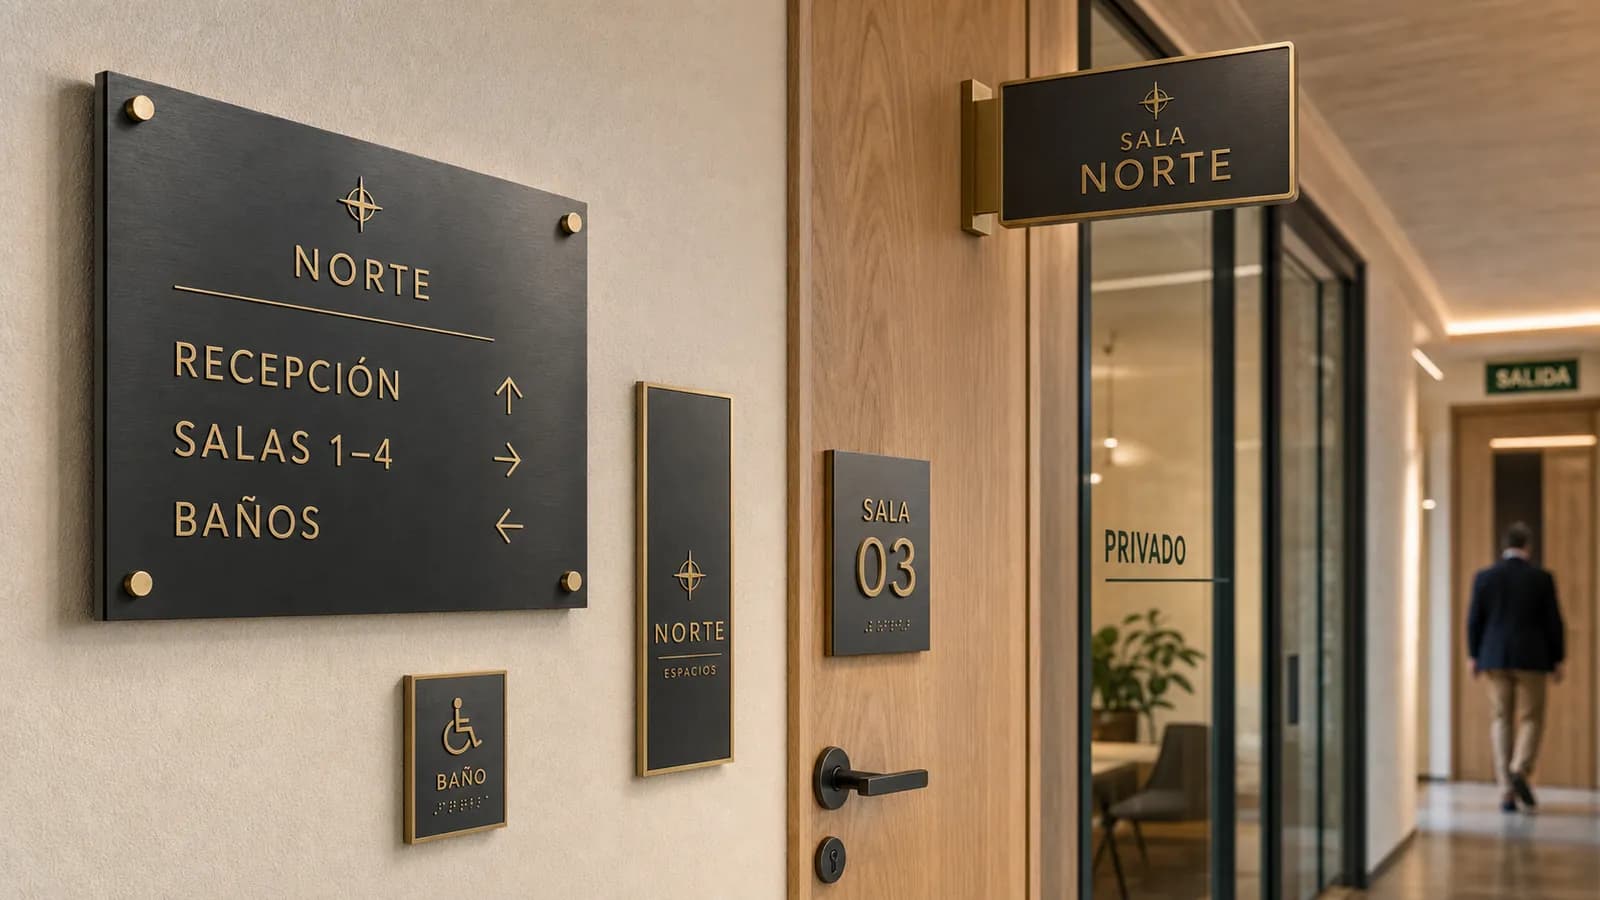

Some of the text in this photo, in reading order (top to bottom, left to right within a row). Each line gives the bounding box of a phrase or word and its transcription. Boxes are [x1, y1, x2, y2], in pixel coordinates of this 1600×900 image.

[1121, 127, 1186, 151] SALA
[1080, 148, 1232, 195] NORTE
[294, 244, 430, 300] NORTE
[174, 341, 400, 401] RECEPCIÓN
[1495, 366, 1572, 389] SALIDA
[174, 420, 310, 465] SALAS
[174, 495, 320, 541] BAÑOS
[863, 498, 910, 523] SALA
[1104, 529, 1186, 565] PRIVADO
[857, 536, 916, 597] 03
[655, 620, 725, 644] NORTE
[663, 664, 717, 679] ESPACIOS
[436, 766, 487, 792] BAÑO
